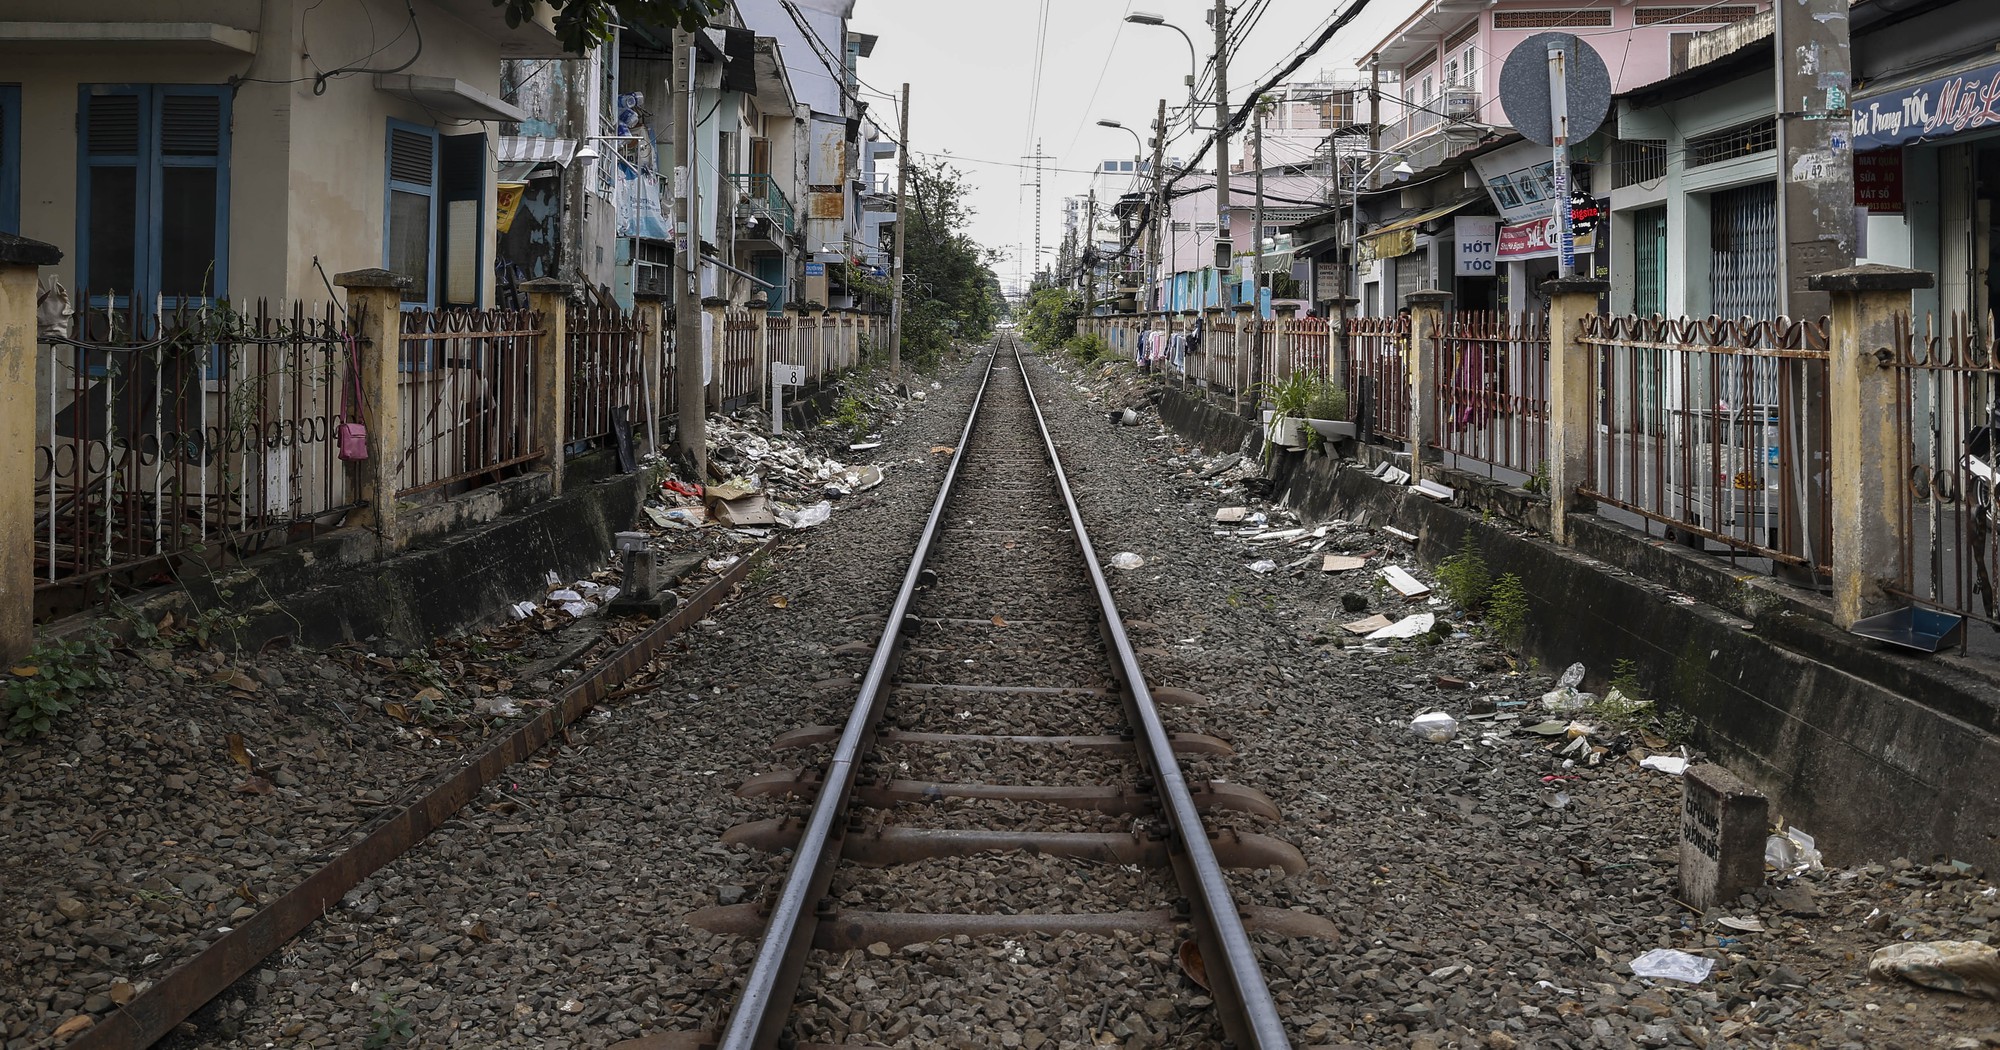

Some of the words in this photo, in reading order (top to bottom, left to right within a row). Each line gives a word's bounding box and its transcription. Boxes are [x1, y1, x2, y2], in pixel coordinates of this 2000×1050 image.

[1852, 108, 1869, 137] hời
[1870, 102, 1902, 136] Trang
[1902, 88, 1929, 127] TÓC
[1923, 77, 1981, 133] Mỹ
[1571, 207, 1598, 220] Bigsize
[1463, 240, 1492, 252] HỚT
[1463, 257, 1492, 270] TÓC
[790, 371, 798, 384] 8
